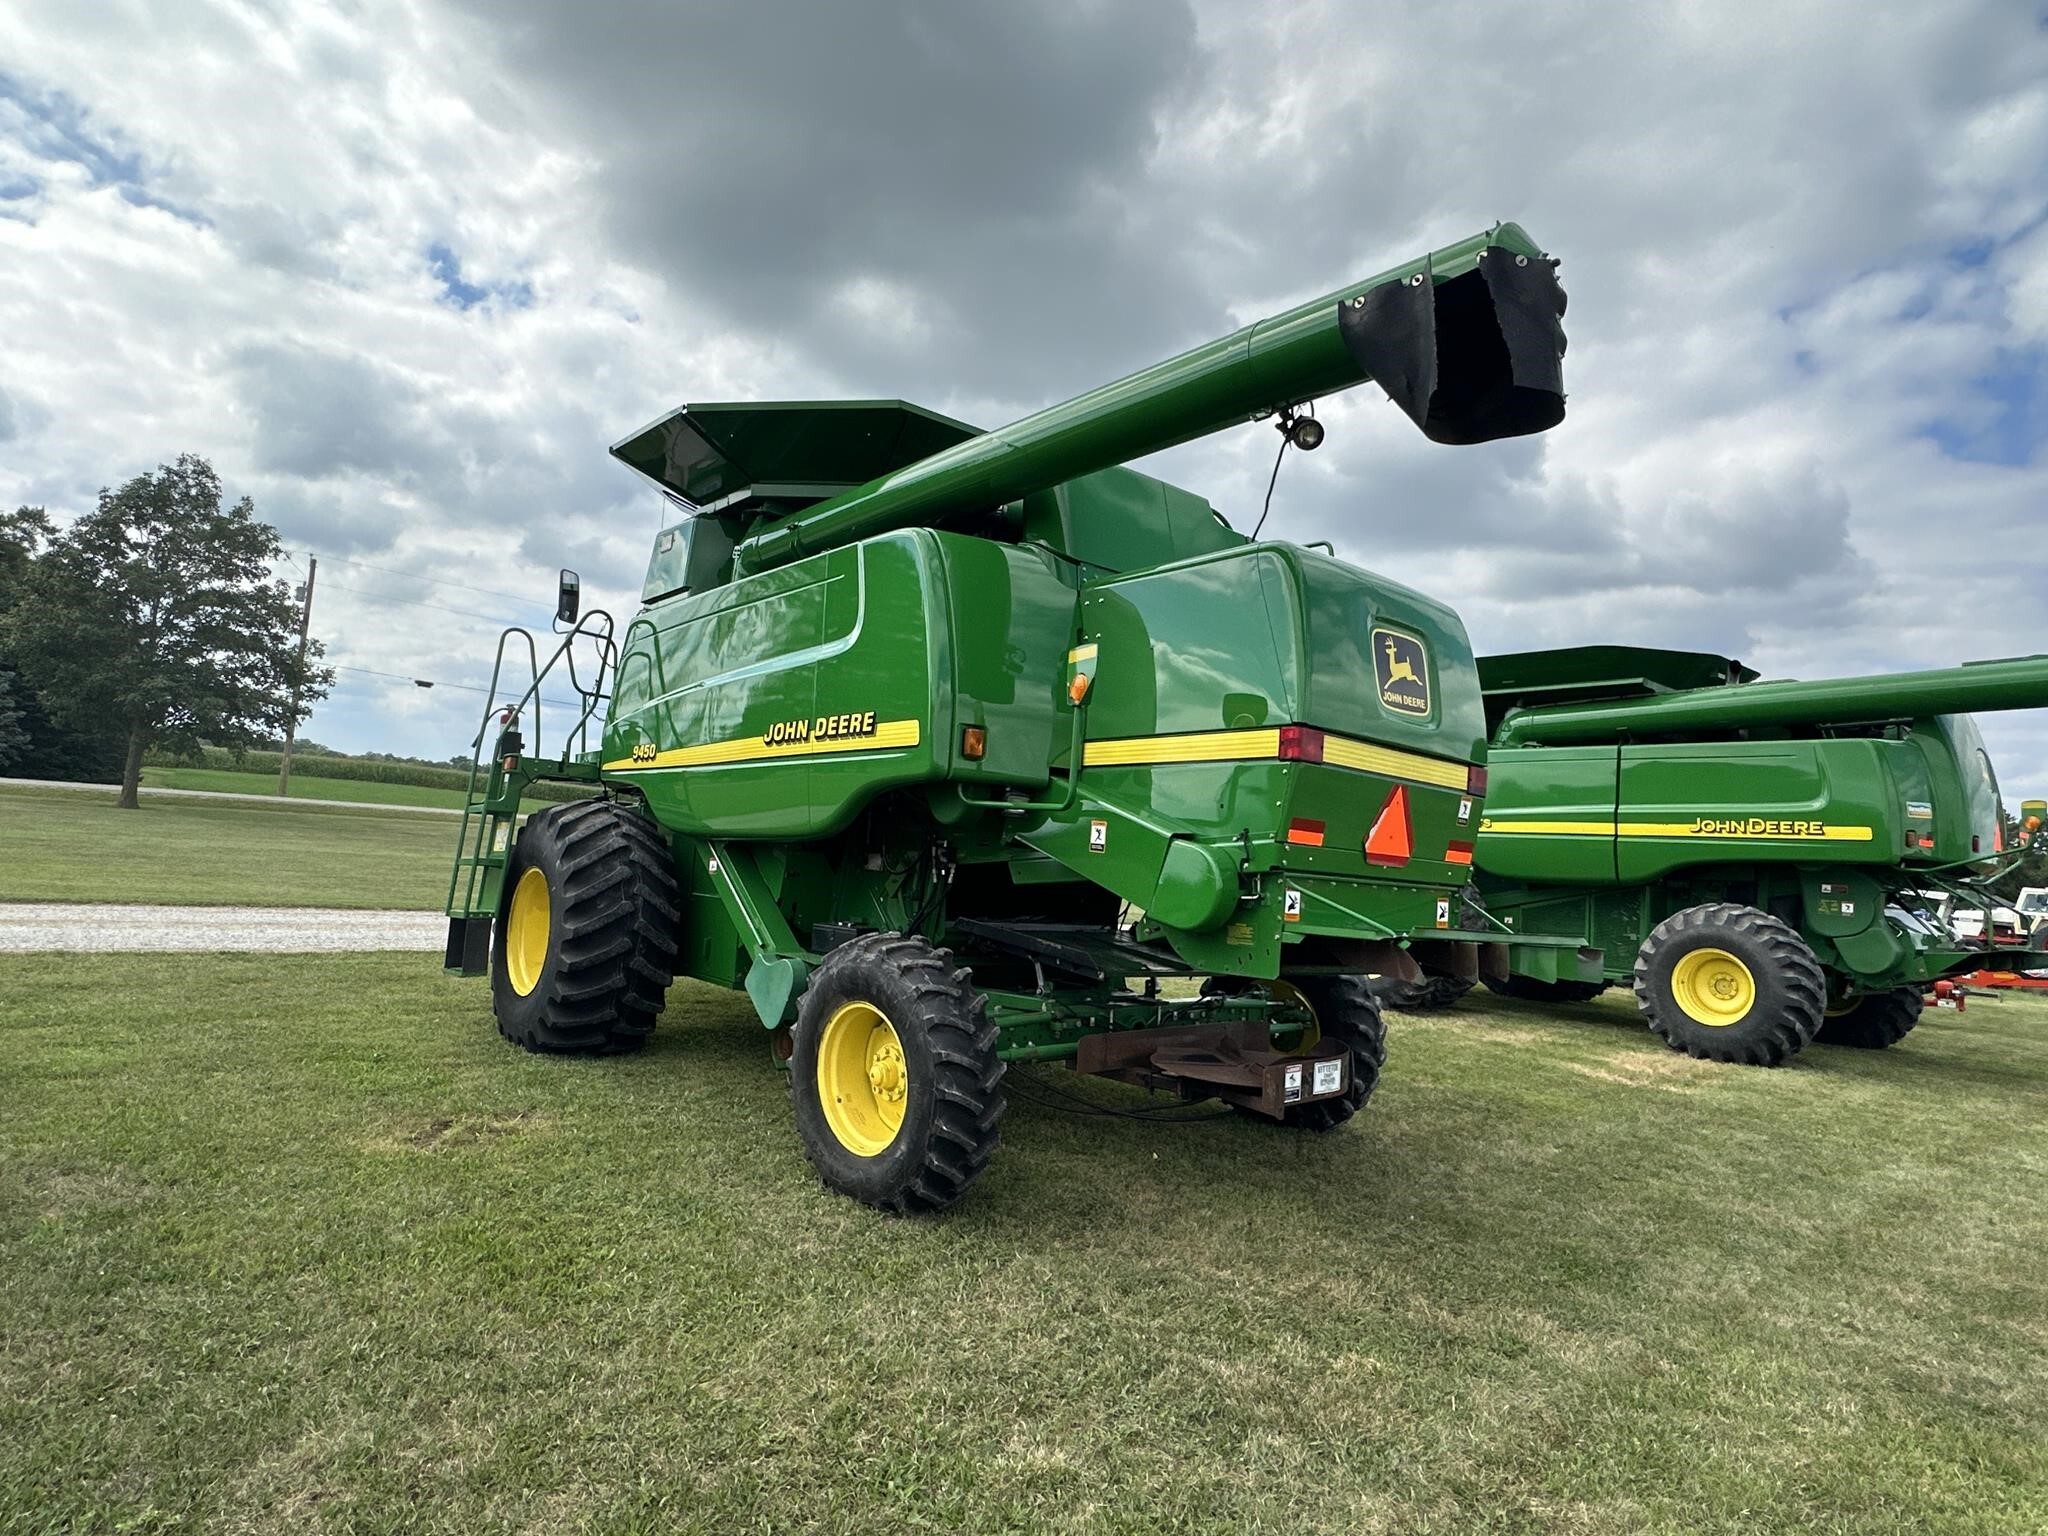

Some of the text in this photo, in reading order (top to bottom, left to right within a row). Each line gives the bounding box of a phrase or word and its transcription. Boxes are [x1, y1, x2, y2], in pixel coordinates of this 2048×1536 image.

[1383, 691, 1426, 709] JOHN DEERE
[764, 711, 875, 744] JOHN DEERE
[632, 744, 656, 761] 9450
[1690, 817, 1824, 835] JOHN DEERE
